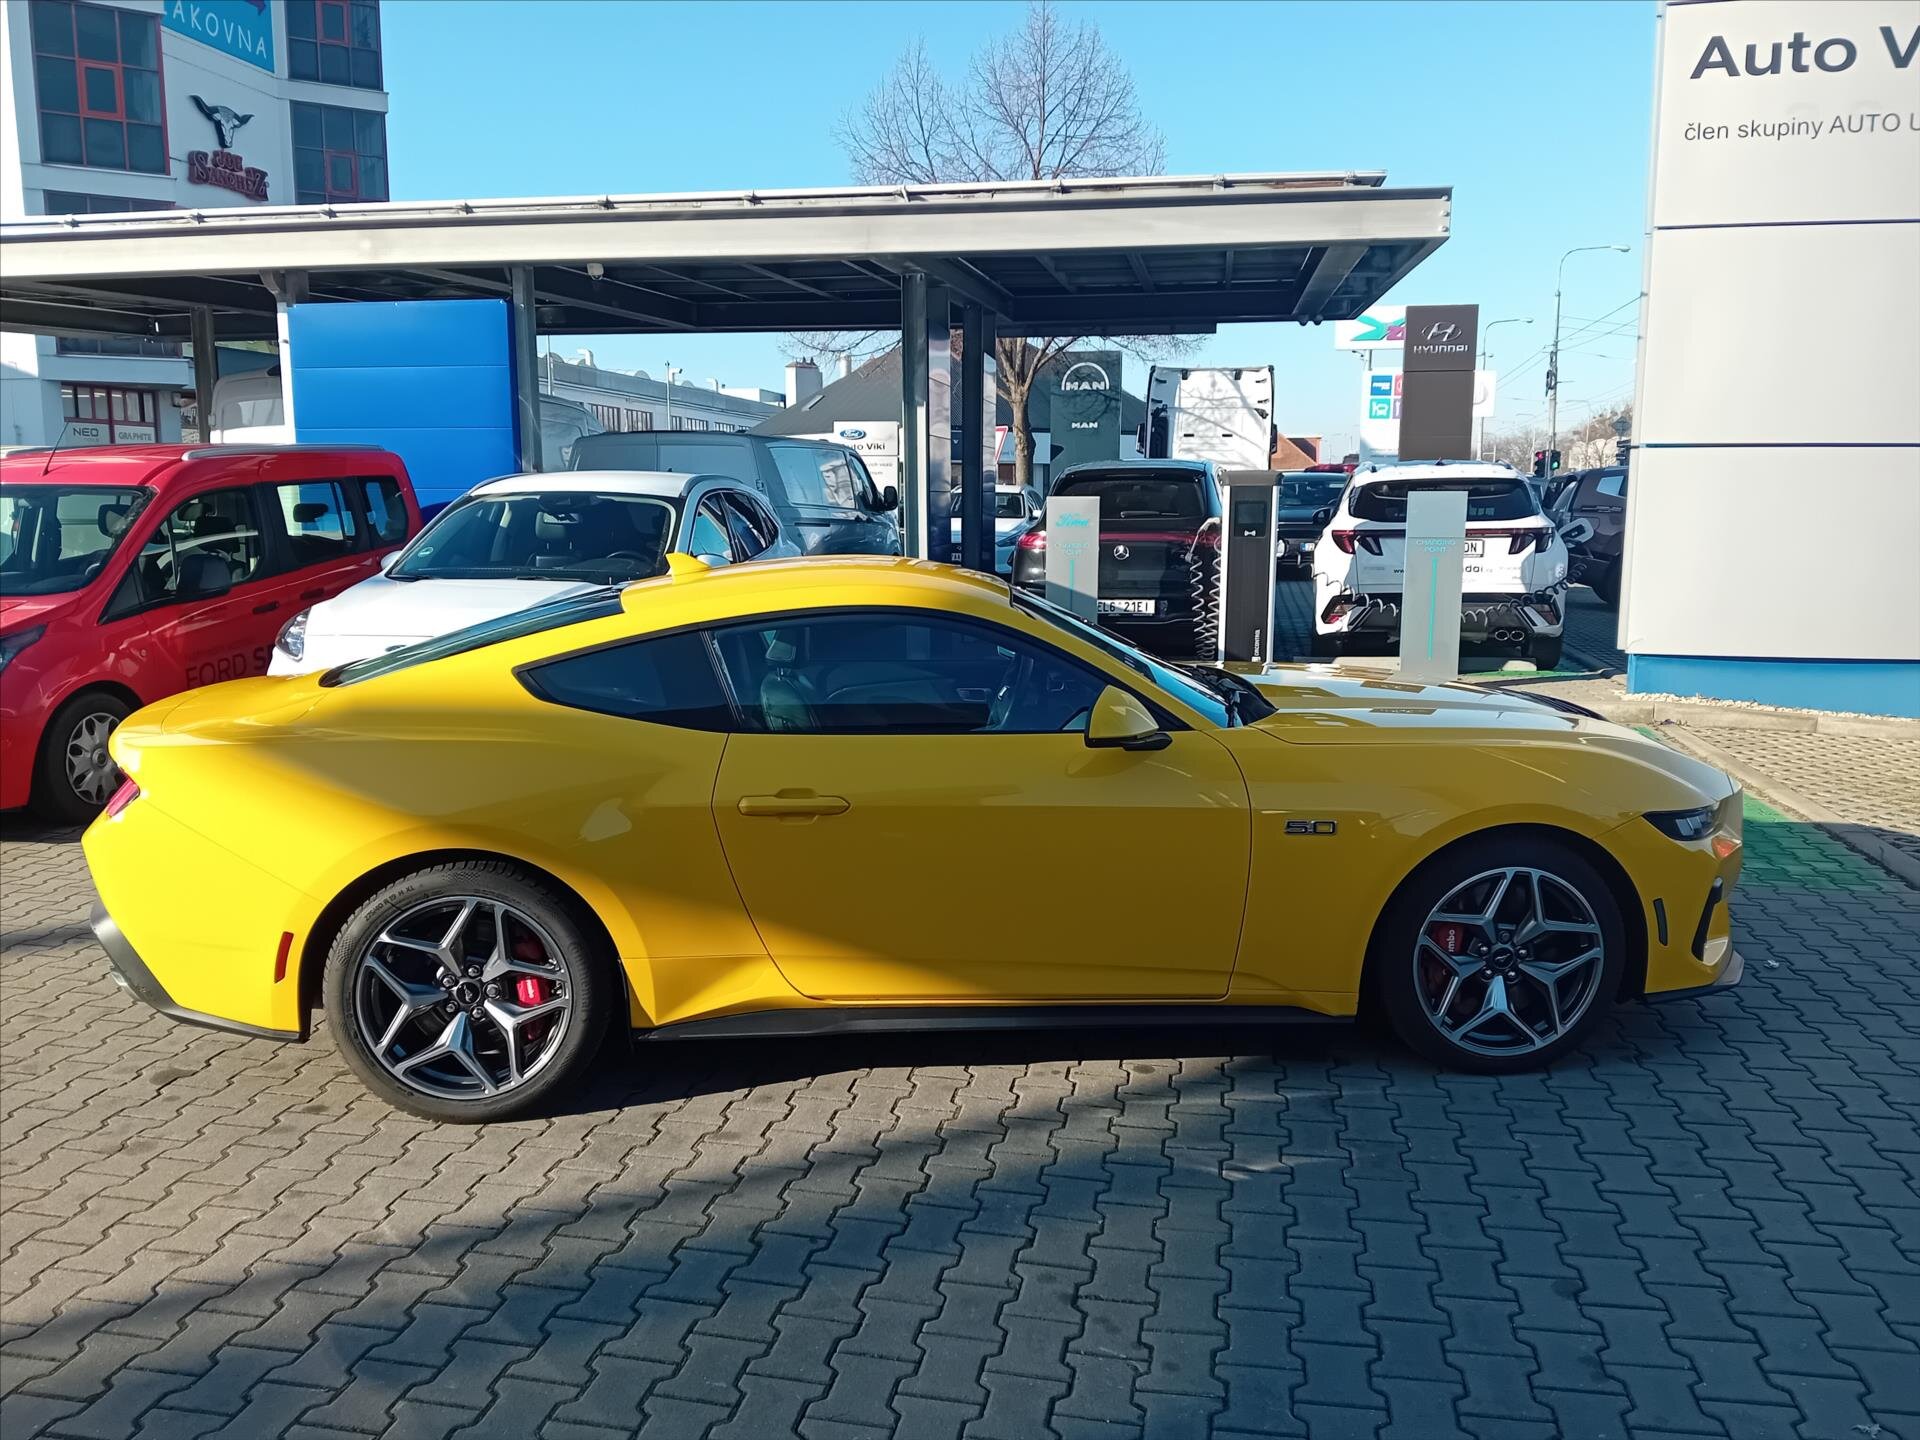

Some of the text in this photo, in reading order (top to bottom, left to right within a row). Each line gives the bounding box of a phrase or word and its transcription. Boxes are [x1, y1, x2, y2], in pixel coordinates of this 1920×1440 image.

[1690, 31, 1857, 80] Auto
[1684, 122, 1729, 141] člen
[1737, 117, 1824, 141] skupiny
[1829, 112, 1901, 134] AUTO
[1413, 344, 1469, 354] HYUNDAI
[1065, 381, 1105, 391] MAN
[1071, 421, 1098, 429] MAN
[73, 427, 99, 437] NEO
[118, 431, 152, 441] GRAPHITE
